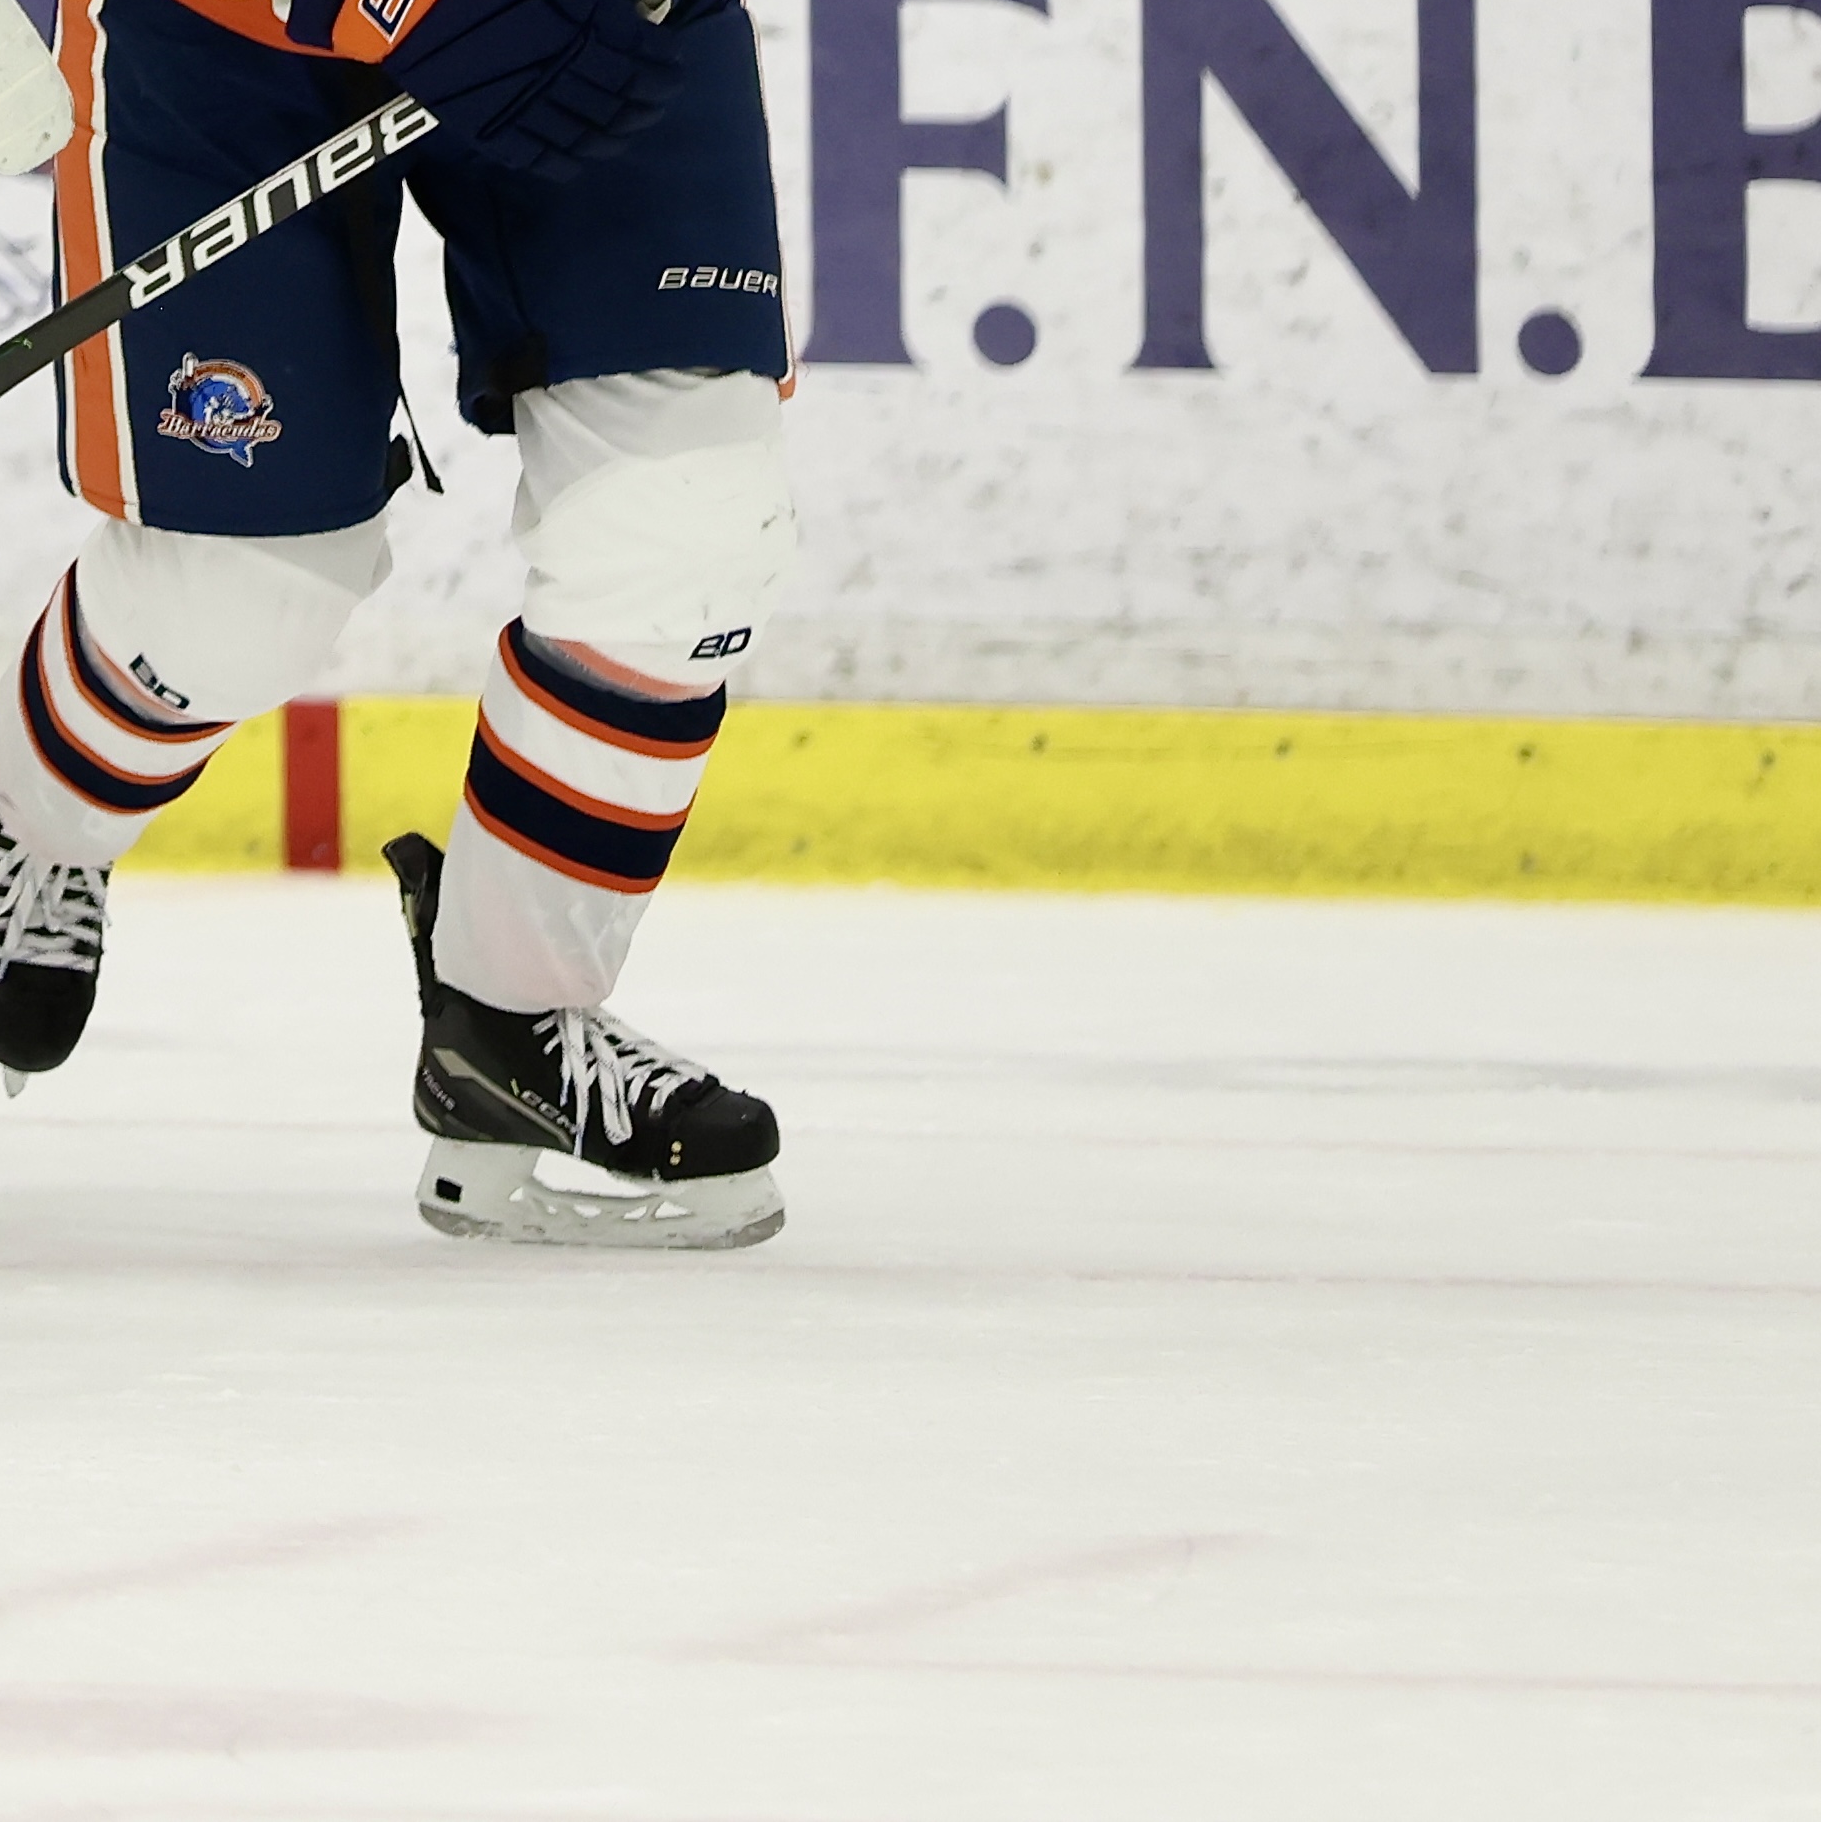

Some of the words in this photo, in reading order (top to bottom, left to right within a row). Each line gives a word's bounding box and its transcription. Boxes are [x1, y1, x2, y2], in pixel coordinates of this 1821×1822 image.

[122, 94, 440, 311] BAUER
[657, 264, 781, 299] BAUER
[688, 626, 753, 662] BD
